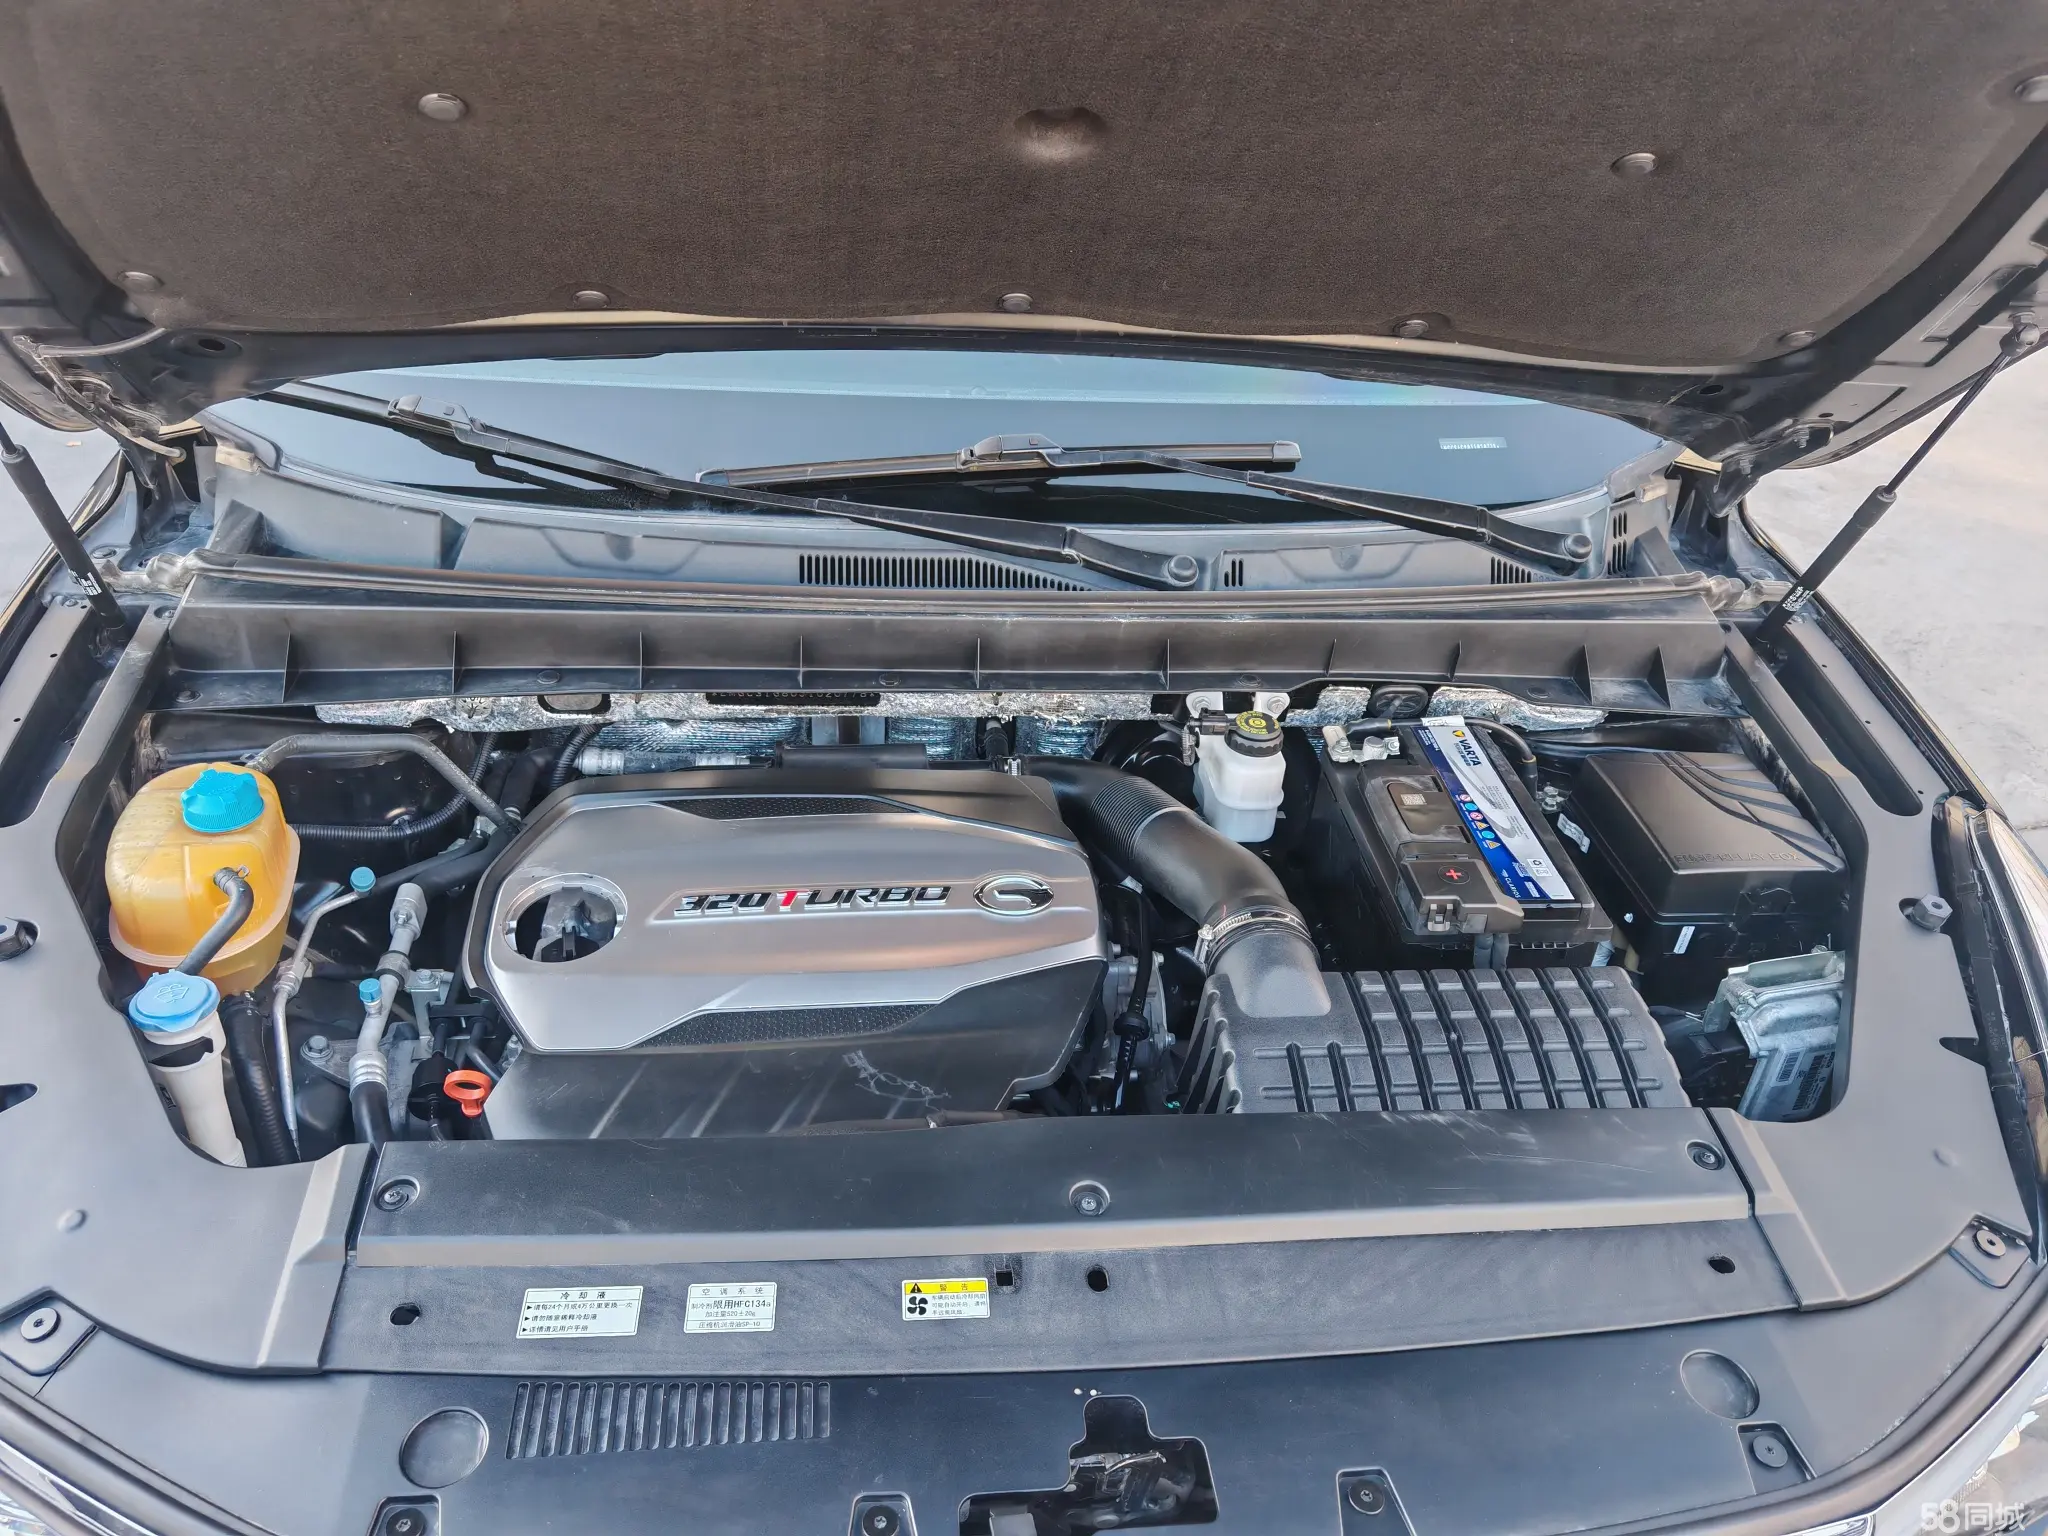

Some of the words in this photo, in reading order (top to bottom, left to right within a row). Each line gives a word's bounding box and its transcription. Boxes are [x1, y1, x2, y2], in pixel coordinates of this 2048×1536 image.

[1459, 739, 1482, 767] VARTA
[701, 1286, 764, 1296] 空调系统
[939, 1283, 968, 1292] 警告
[560, 1291, 606, 1300] 冷却液
